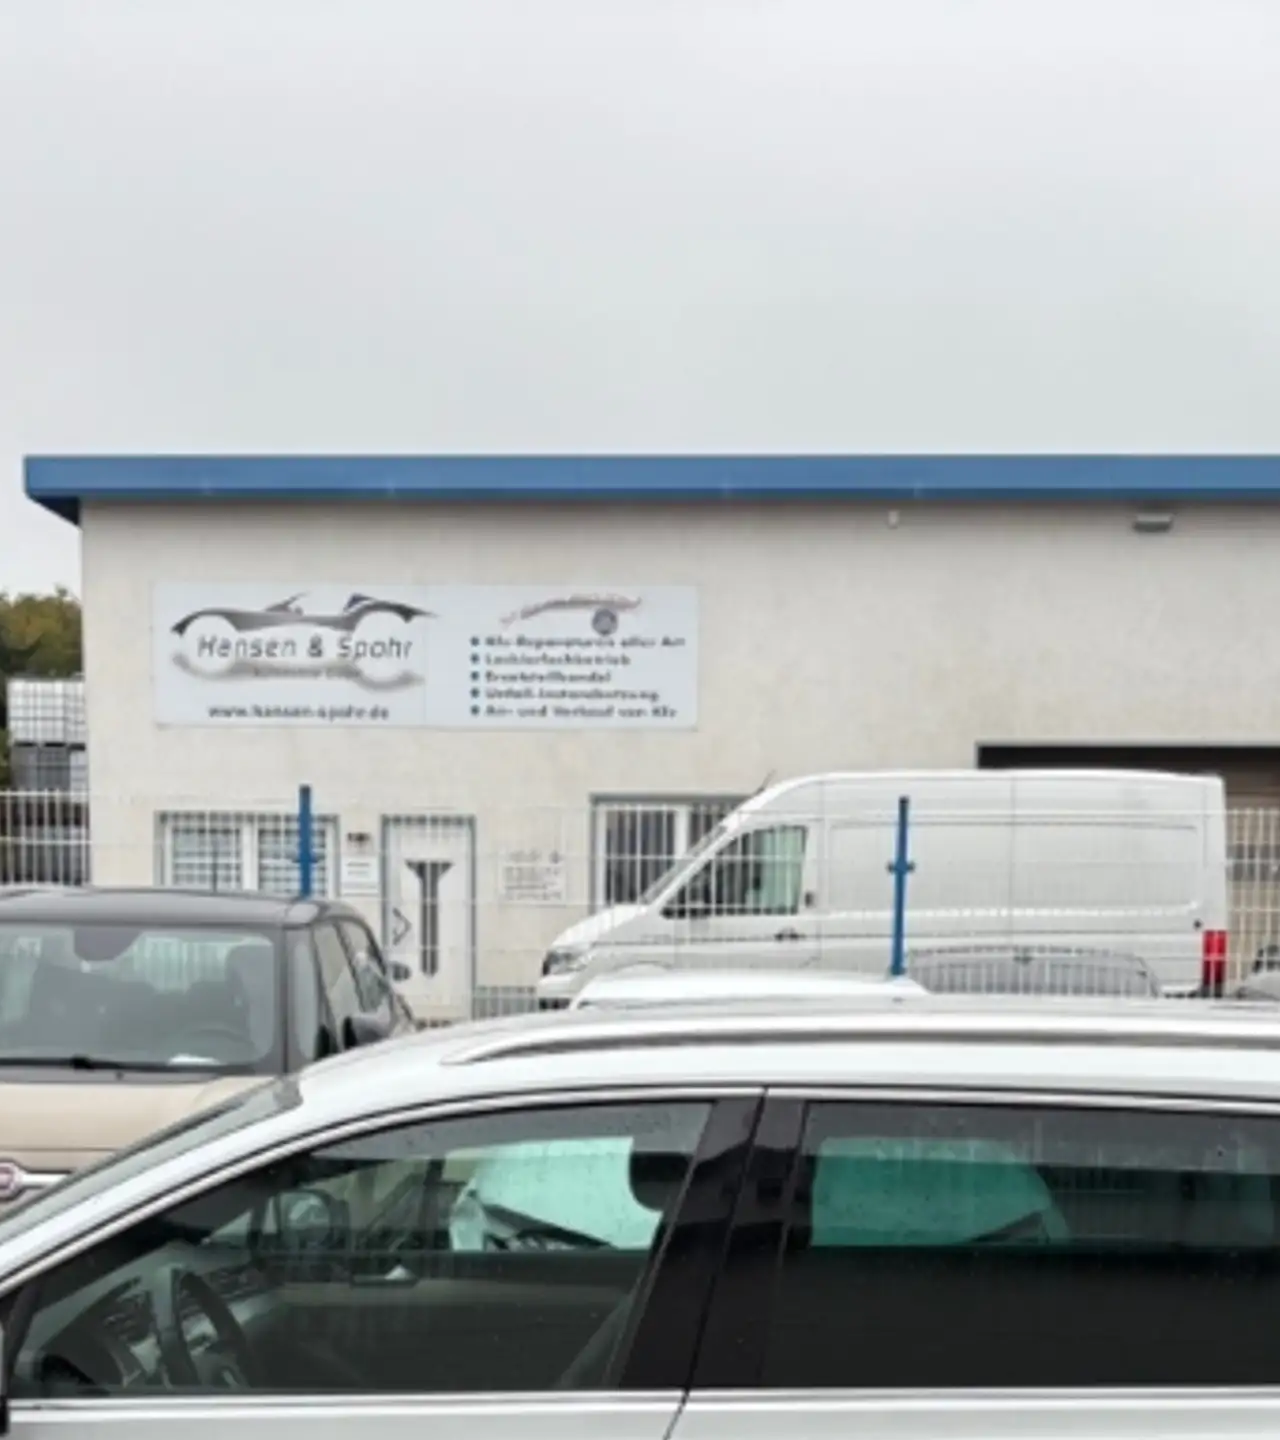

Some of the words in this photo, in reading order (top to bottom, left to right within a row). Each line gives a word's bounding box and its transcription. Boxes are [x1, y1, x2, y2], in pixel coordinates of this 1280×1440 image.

[307, 634, 324, 659] &
[337, 635, 413, 662] Spohr
[517, 705, 547, 718] und
